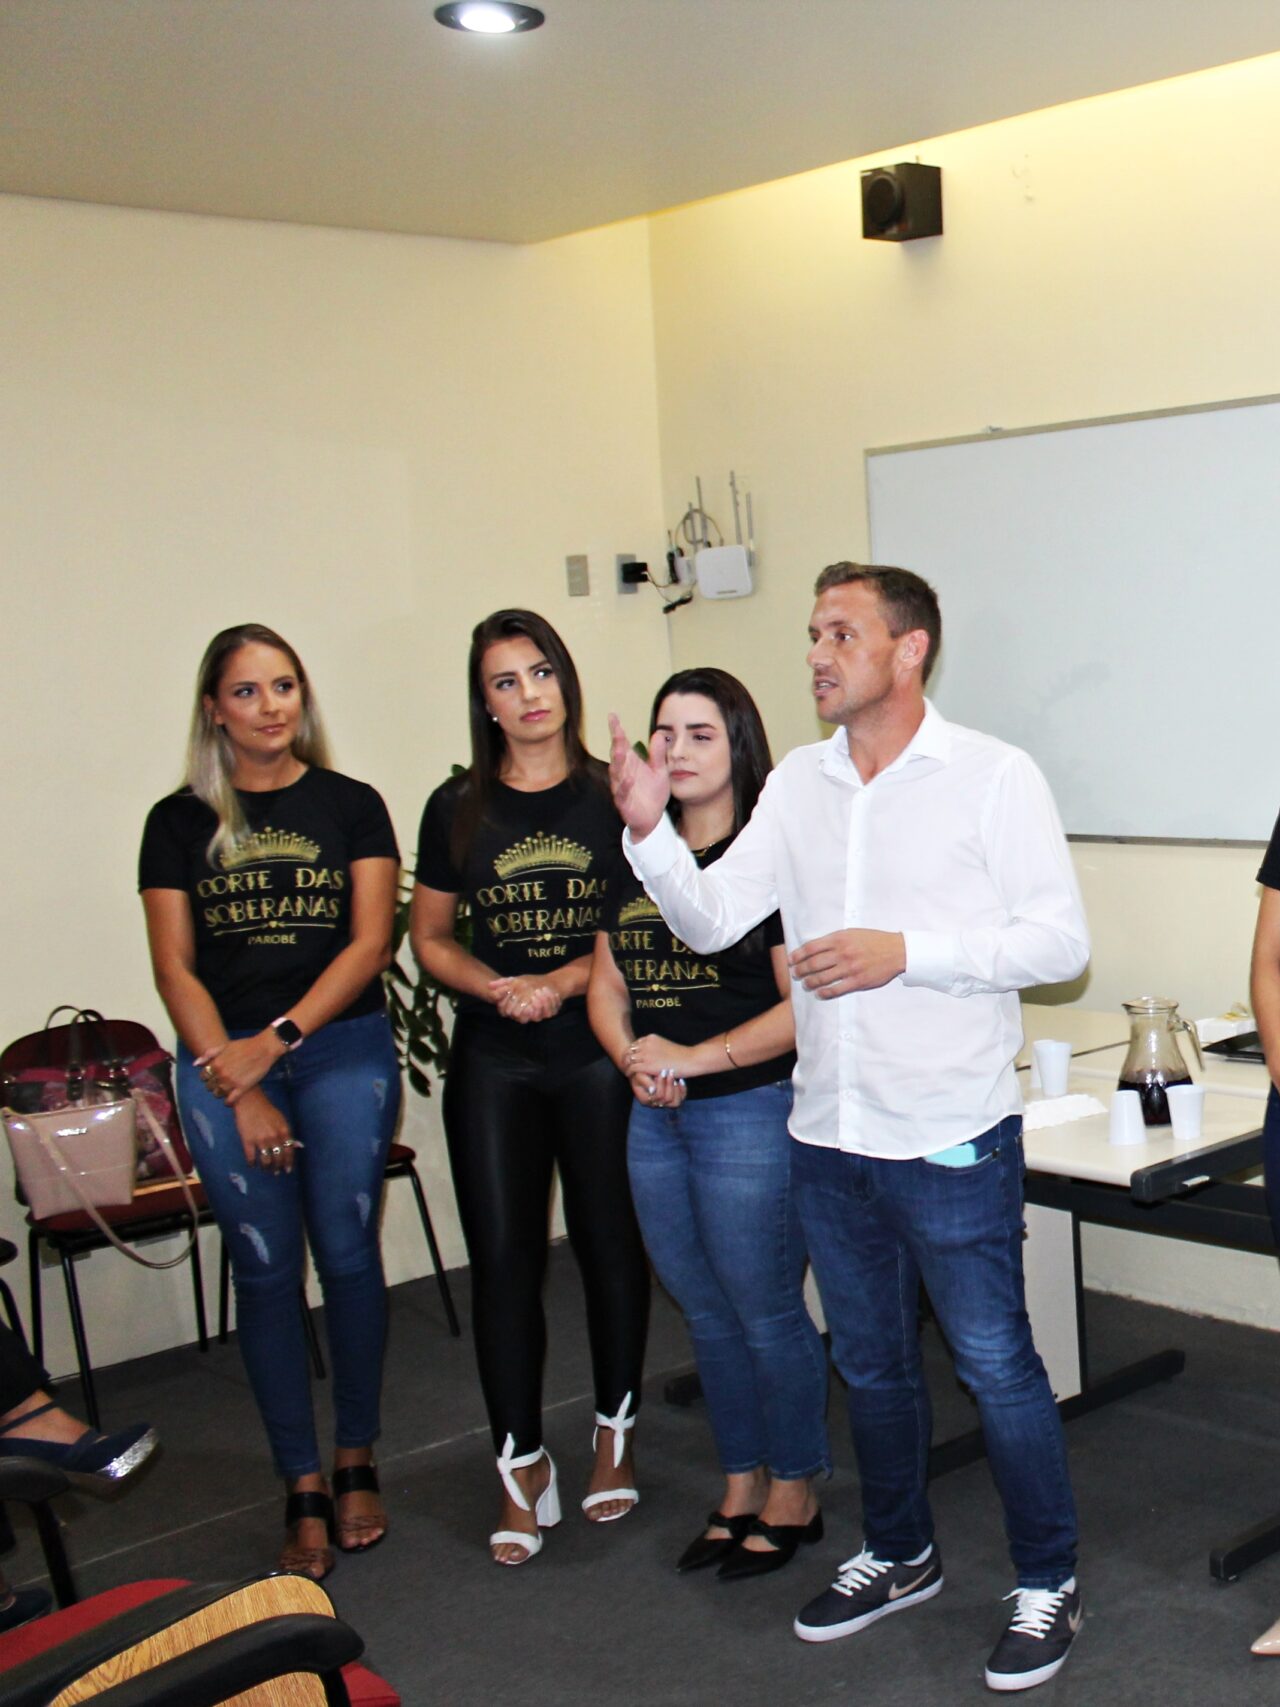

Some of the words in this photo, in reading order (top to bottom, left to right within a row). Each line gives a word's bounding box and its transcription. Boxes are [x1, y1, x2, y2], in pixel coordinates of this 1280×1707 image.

[197, 871, 273, 898] CORTE
[296, 868, 344, 890] DAS
[476, 881, 548, 907] CORTE
[203, 896, 340, 928] SOBERANAS
[248, 933, 297, 945] PAROBÉ
[610, 931, 654, 950] ORTE
[620, 959, 719, 981] BERANAS
[636, 996, 682, 1009] PAROBÉ
